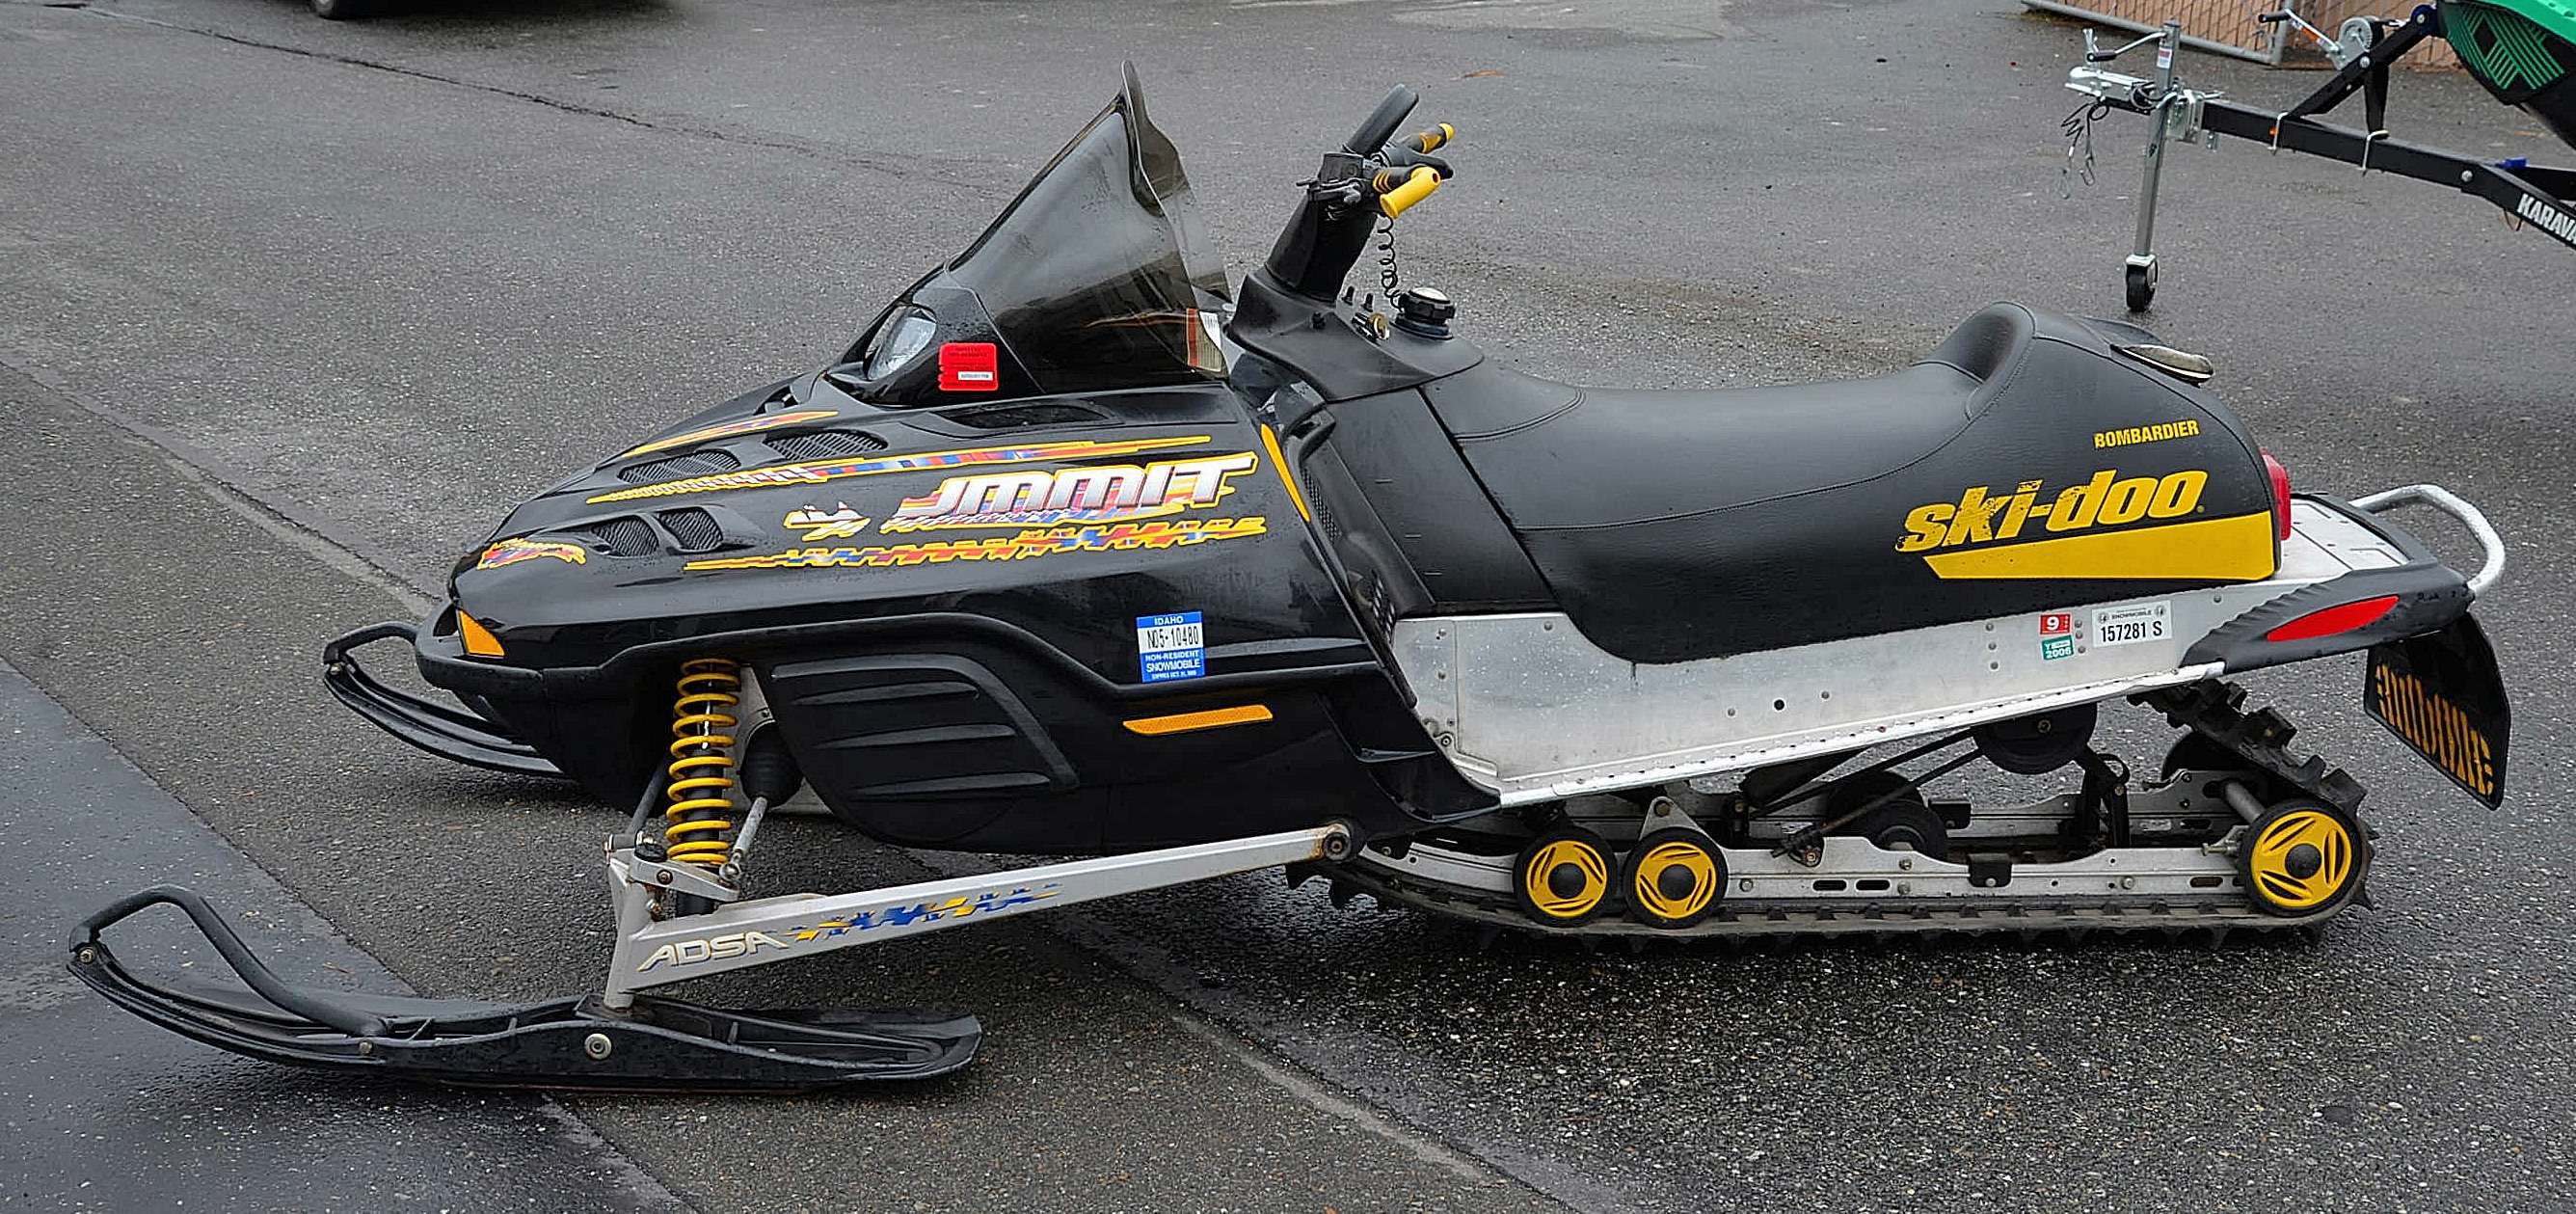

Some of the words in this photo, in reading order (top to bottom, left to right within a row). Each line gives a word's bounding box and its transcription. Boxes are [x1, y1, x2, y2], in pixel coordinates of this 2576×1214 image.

[2094, 419, 2199, 448] BOMBARDIER
[1895, 470, 2208, 553] ski-doo
[1154, 616, 1184, 625] IDAHO
[2046, 615, 2060, 632] 9
[2100, 622, 2146, 642] 157281
[2153, 620, 2162, 636] S
[1145, 651, 1199, 661] NON-RESIDENT
[1145, 659, 1201, 672] SNOWMOBILE
[635, 931, 790, 972] ADSA
